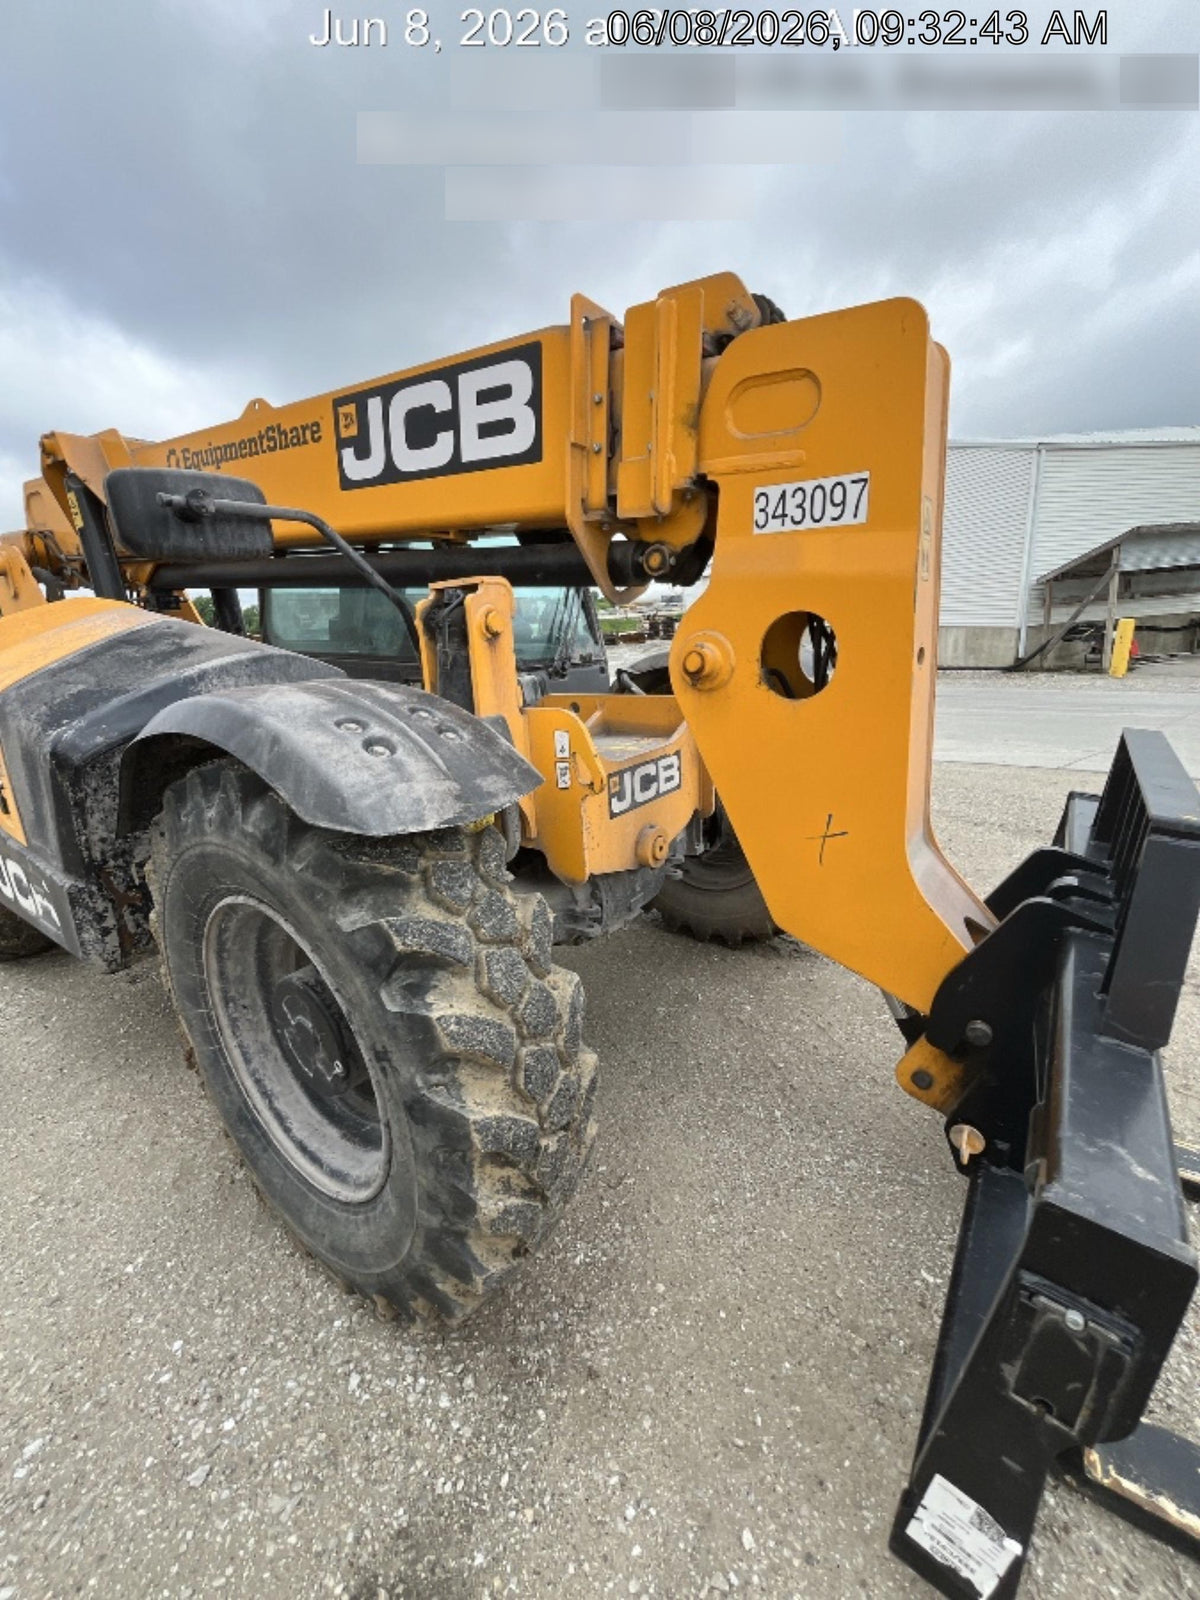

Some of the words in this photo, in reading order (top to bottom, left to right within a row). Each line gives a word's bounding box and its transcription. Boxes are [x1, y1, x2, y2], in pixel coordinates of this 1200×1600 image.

[182, 420, 323, 471] EquipmentShare
[340, 359, 536, 481] JCB
[755, 478, 868, 529] 343097
[611, 754, 680, 814] JCB
